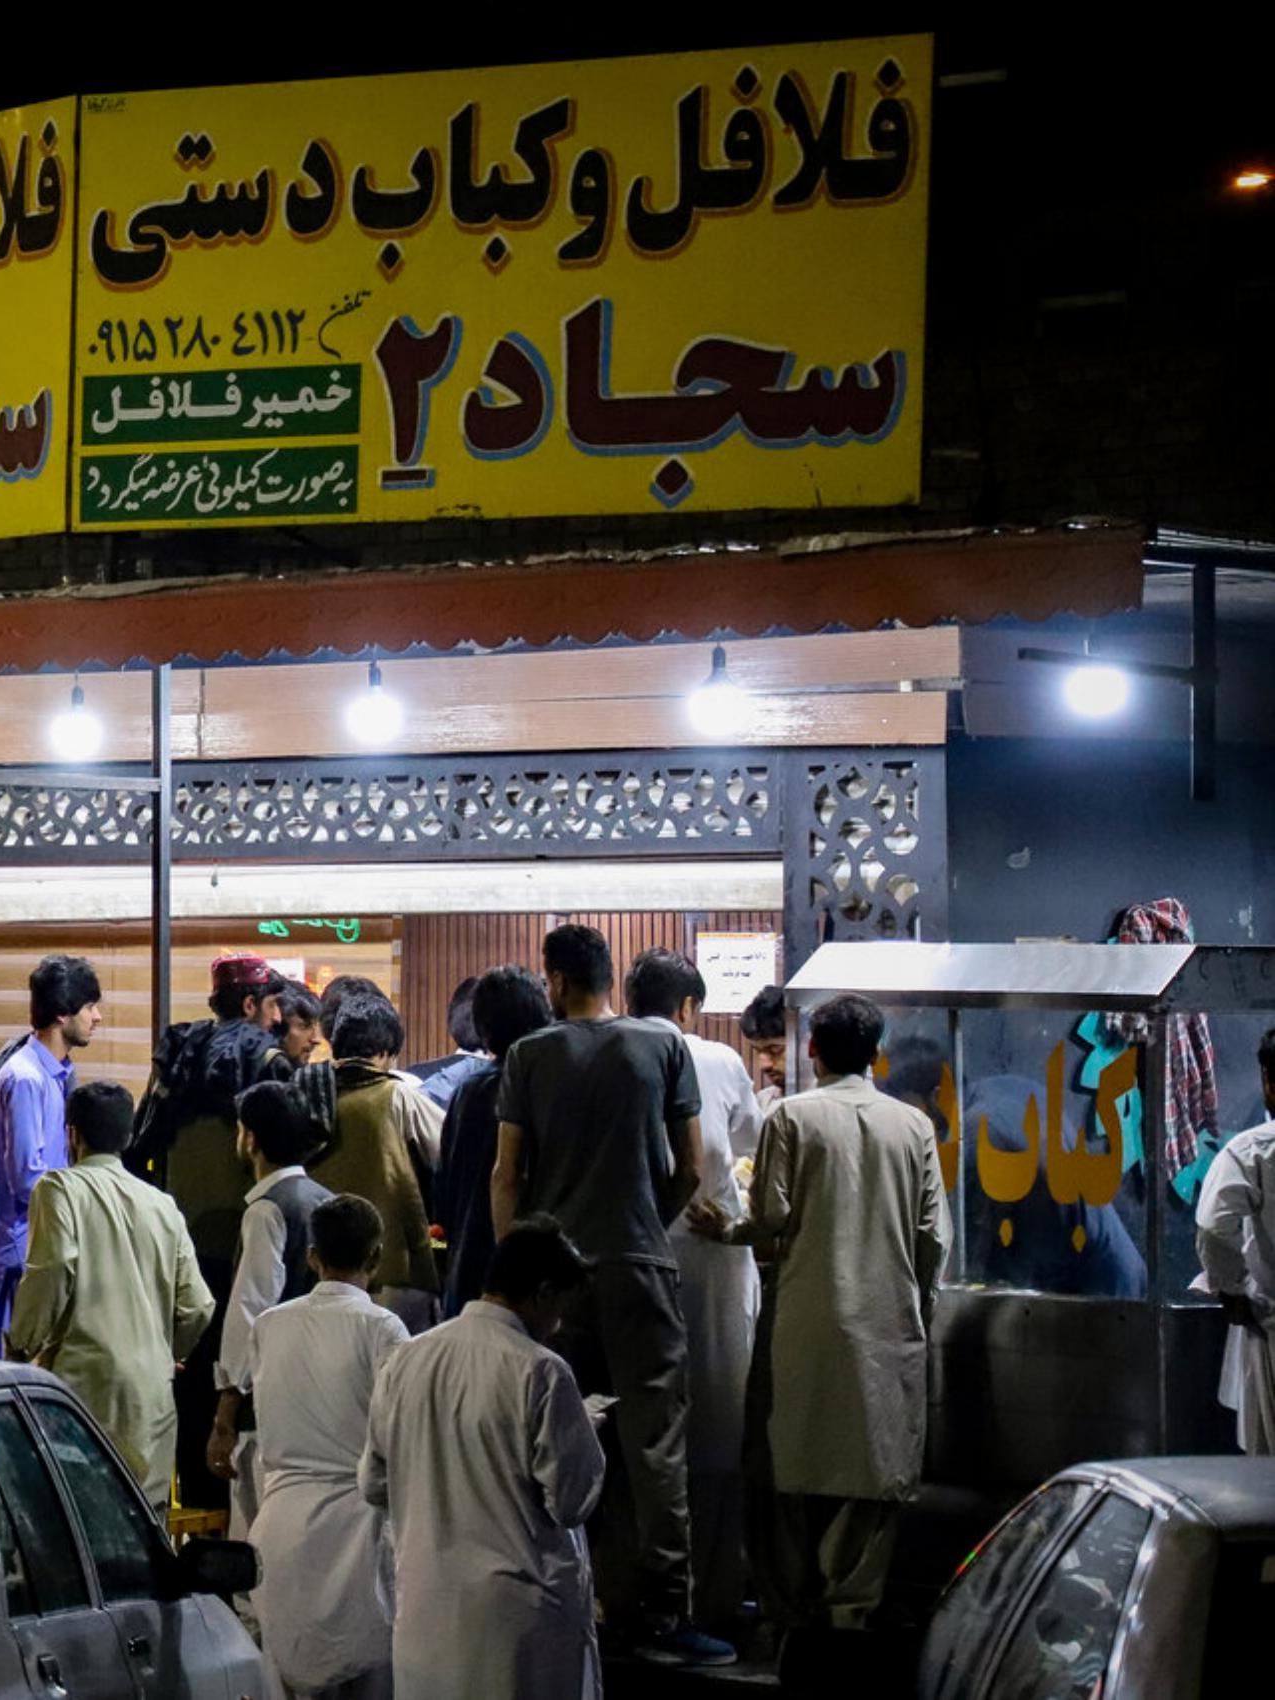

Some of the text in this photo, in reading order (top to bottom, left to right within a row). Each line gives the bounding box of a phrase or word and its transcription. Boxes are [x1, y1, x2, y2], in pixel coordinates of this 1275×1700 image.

[90, 57, 913, 289] فلافل و کباب دستی
[91, 369, 353, 434] خمیر فلافل
[143, 459, 202, 511] عرضه
[374, 295, 906, 509] سجاد ۲
[976, 1039, 1138, 1254] کباب
